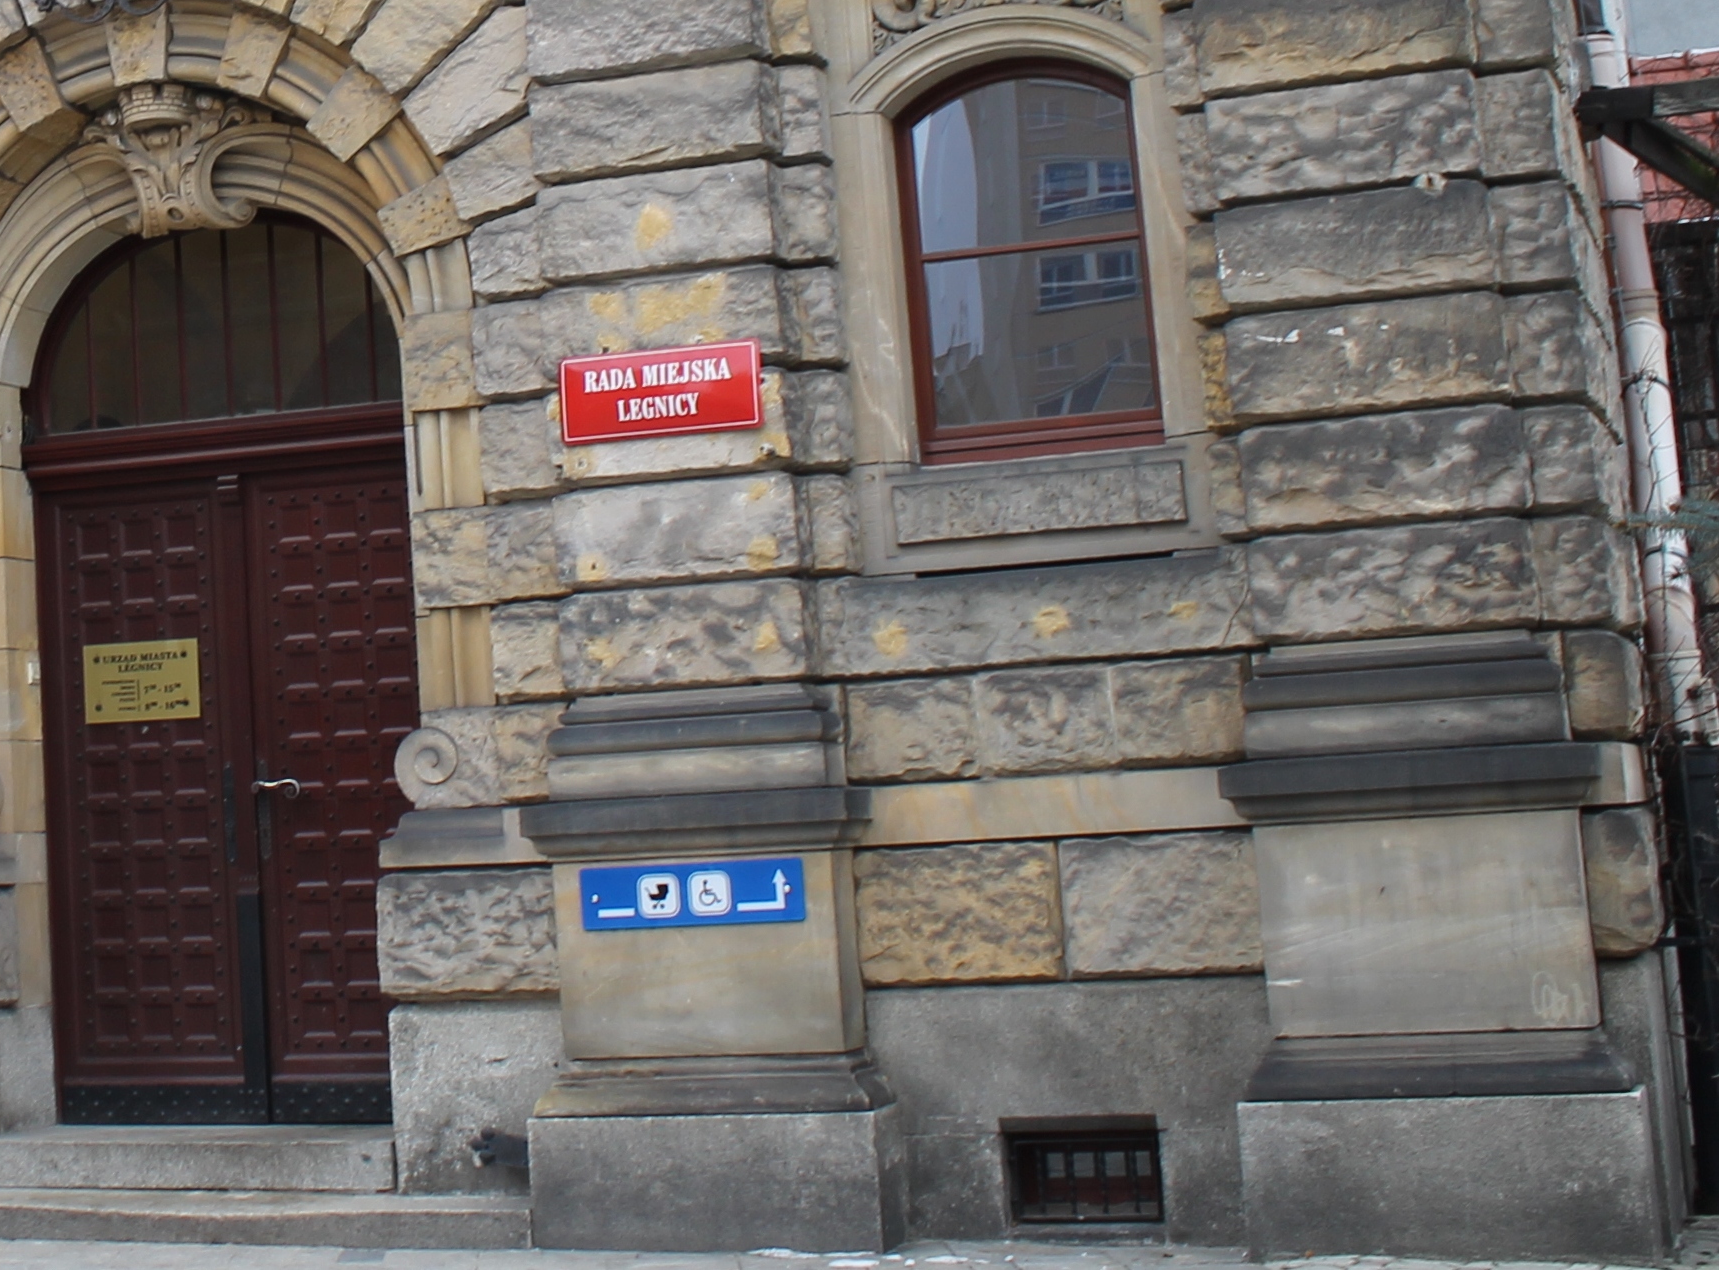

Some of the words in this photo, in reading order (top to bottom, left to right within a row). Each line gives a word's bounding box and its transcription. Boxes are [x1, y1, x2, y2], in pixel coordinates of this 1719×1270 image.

[584, 368, 637, 393] RADA
[642, 357, 731, 387] MIEJSKA
[617, 392, 699, 422] LEGNICY
[140, 651, 178, 662] MIASTA
[118, 662, 163, 673] LEGNICY
